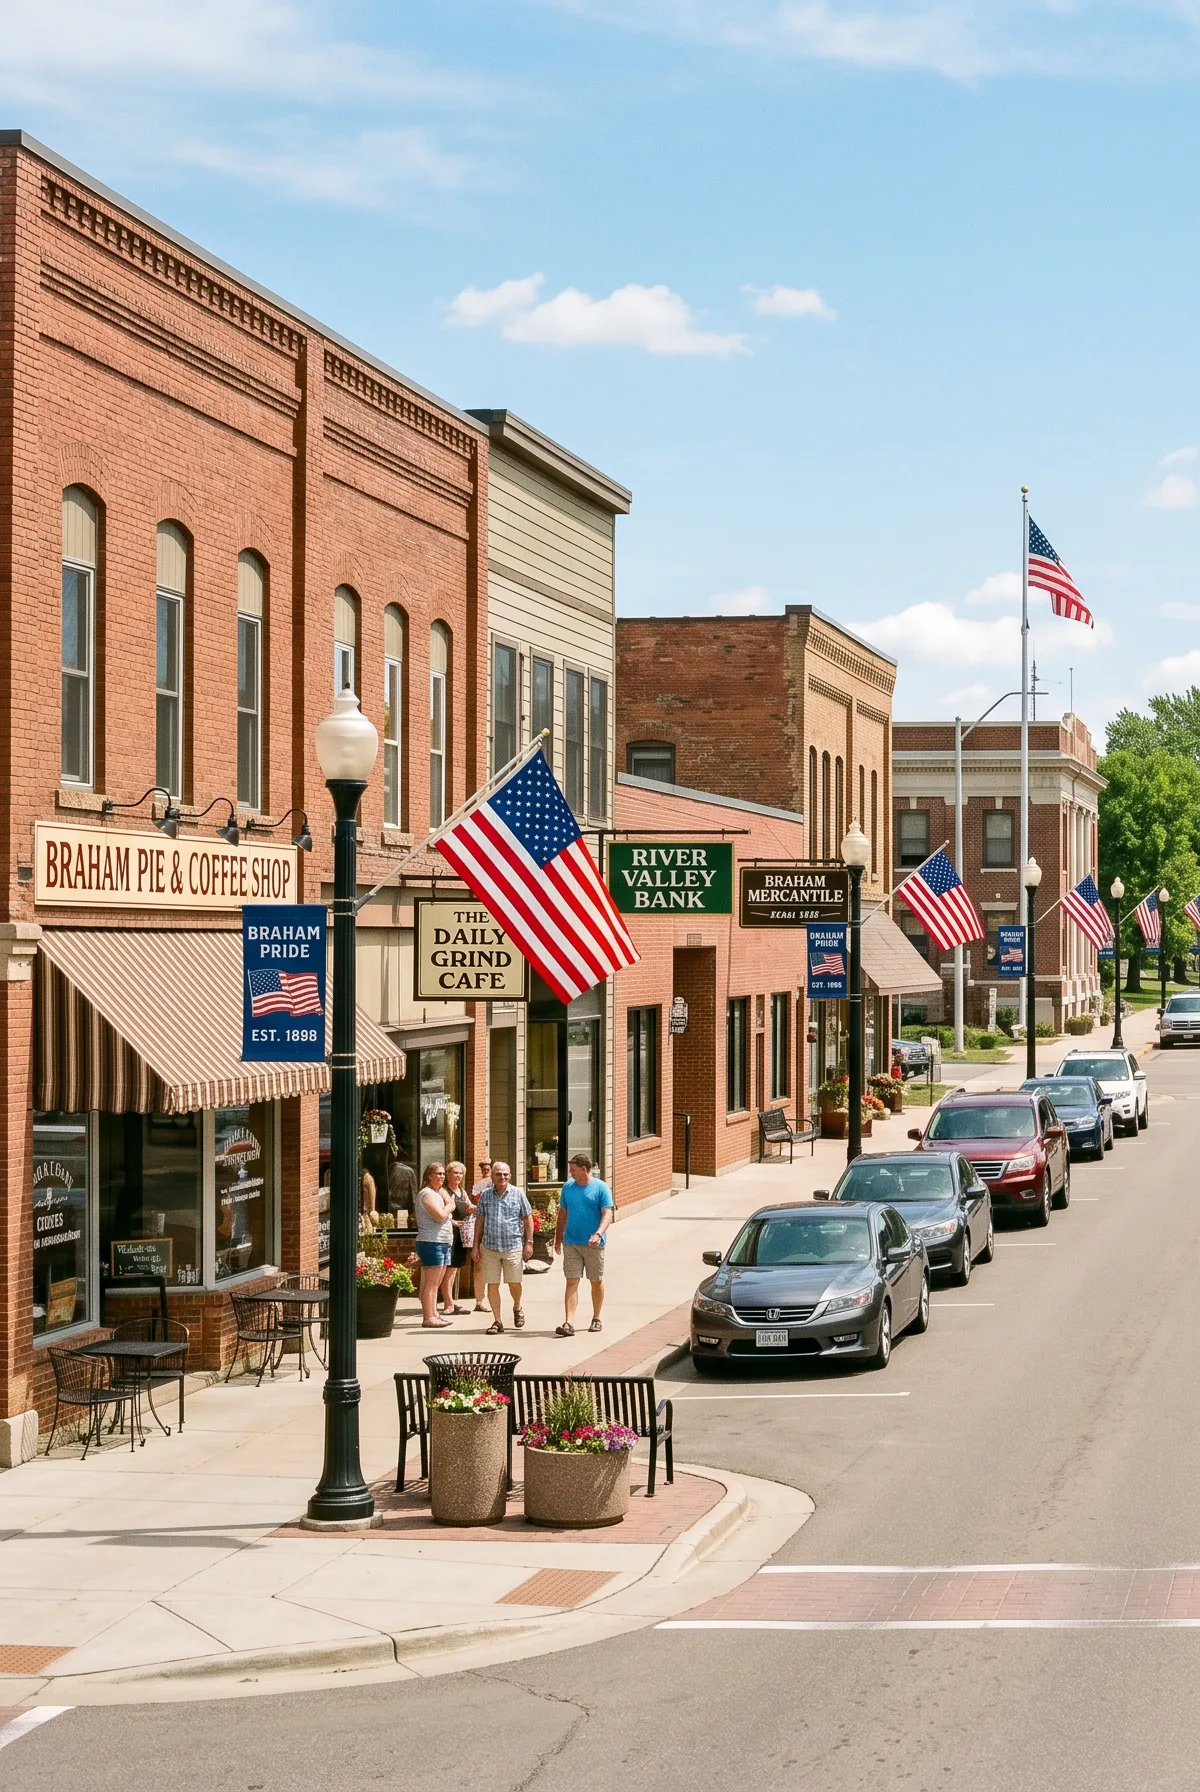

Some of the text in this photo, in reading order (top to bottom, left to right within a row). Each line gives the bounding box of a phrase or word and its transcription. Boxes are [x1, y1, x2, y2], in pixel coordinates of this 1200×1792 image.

[632, 849, 707, 865] RIVER
[46, 841, 290, 898] BRAHAM PIE & COFFEE SHOP
[622, 870, 716, 886] VALLEY
[765, 876, 825, 887] BRAHAM
[634, 891, 705, 907] BANK
[748, 890, 843, 902] MERCANTILE
[453, 911, 489, 923] THE
[248, 926, 320, 939] BRAHAM
[434, 928, 506, 945] DAILY
[261, 944, 309, 957] PRIDE
[431, 951, 511, 967] GRIND
[439, 973, 505, 989] CAFE
[252, 1030, 317, 1041] EST. 1898
